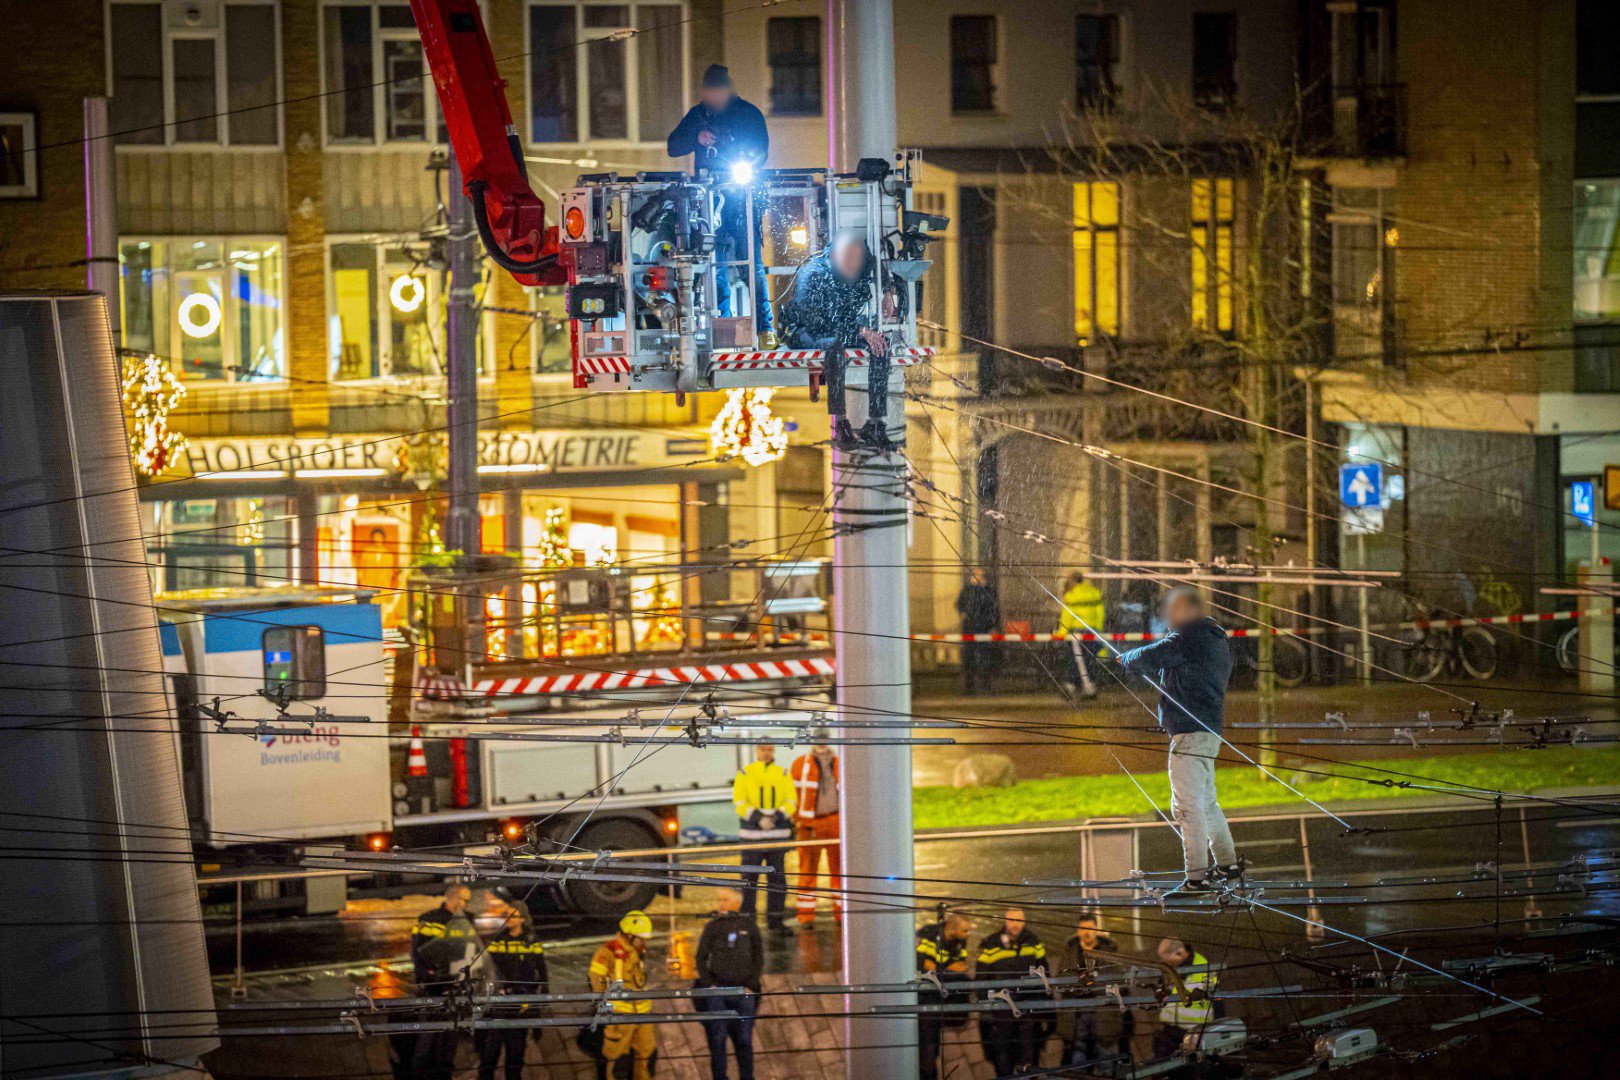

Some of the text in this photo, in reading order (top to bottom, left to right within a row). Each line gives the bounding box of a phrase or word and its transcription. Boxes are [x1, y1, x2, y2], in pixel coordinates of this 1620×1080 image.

[186, 434, 640, 475] HOLSBOER PTOMETRIE
[261, 749, 341, 765] Bovenleiding
